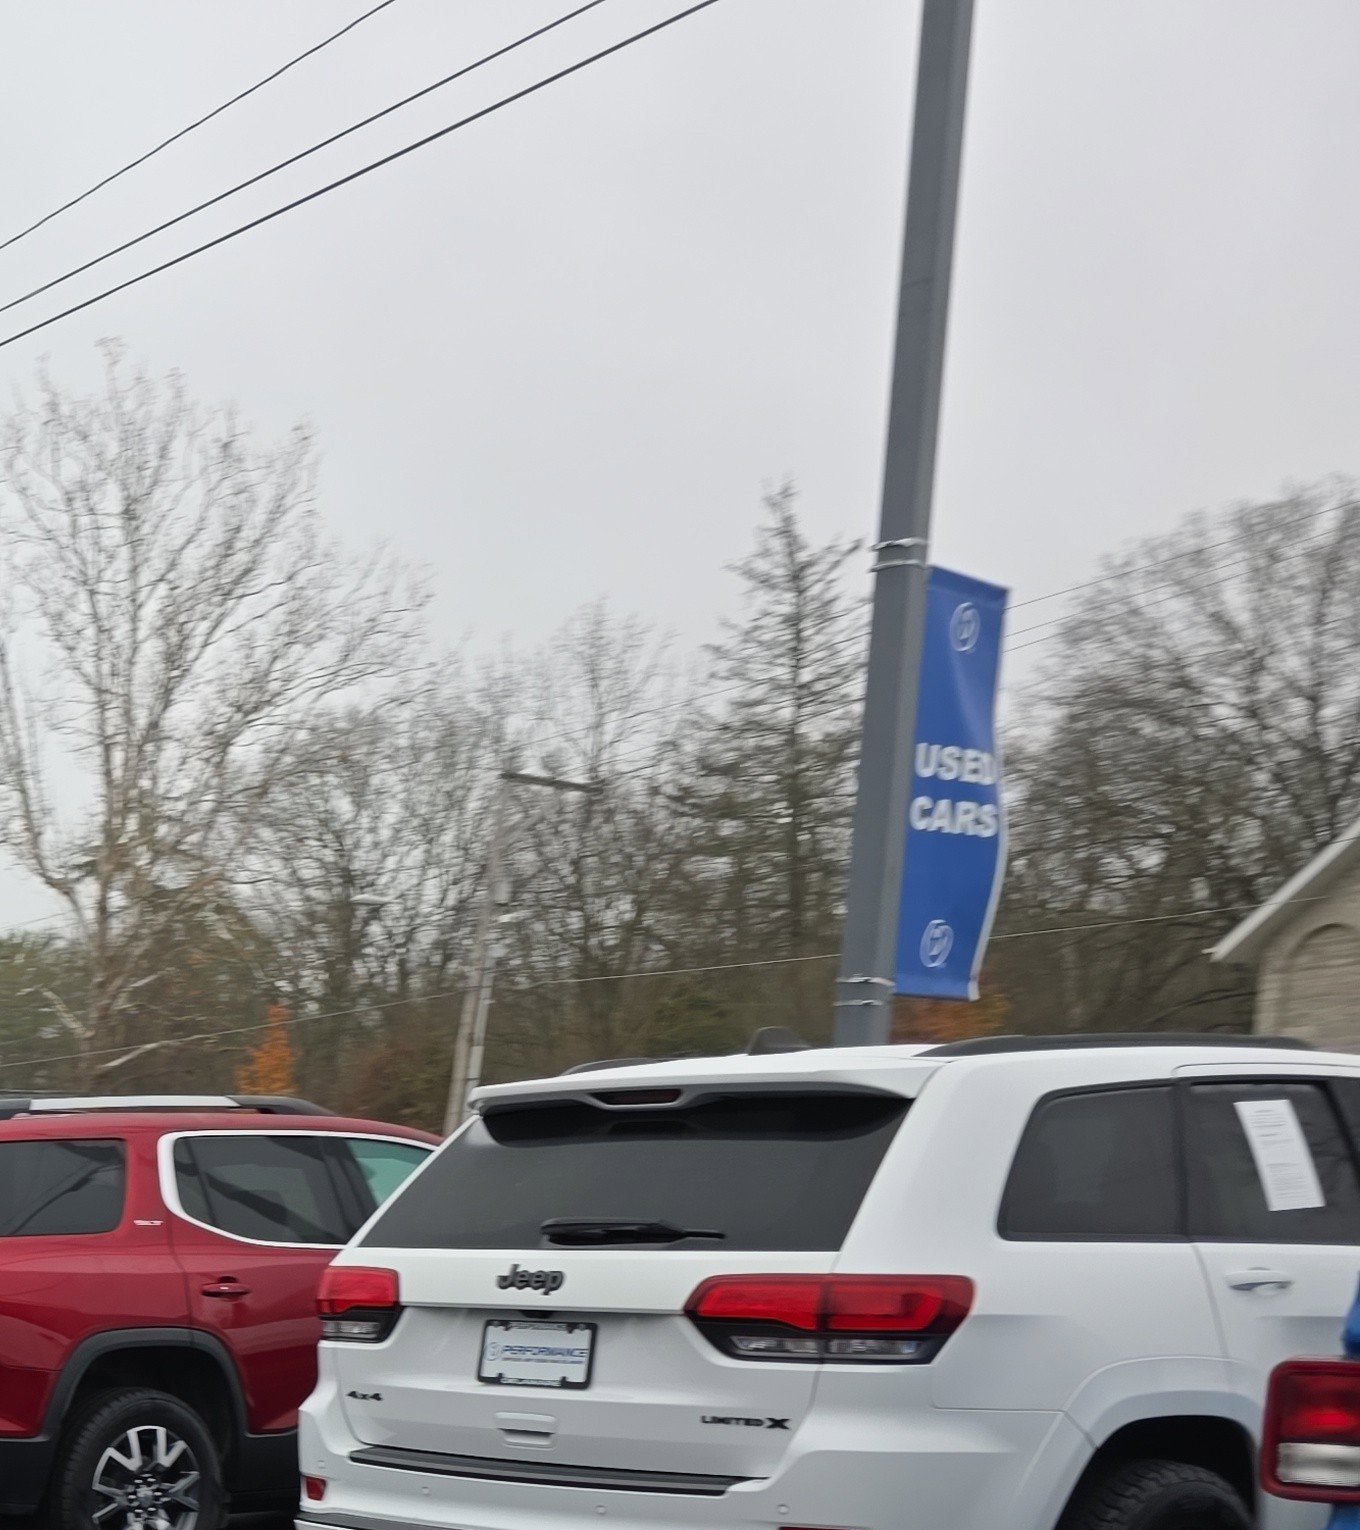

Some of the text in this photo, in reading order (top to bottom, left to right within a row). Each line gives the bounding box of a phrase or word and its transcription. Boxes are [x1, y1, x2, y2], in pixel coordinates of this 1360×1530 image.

[914, 742, 998, 786] USED
[909, 796, 998, 838] CARS
[496, 1263, 565, 1296] Jeep
[501, 1345, 589, 1358] PERFORMANCE
